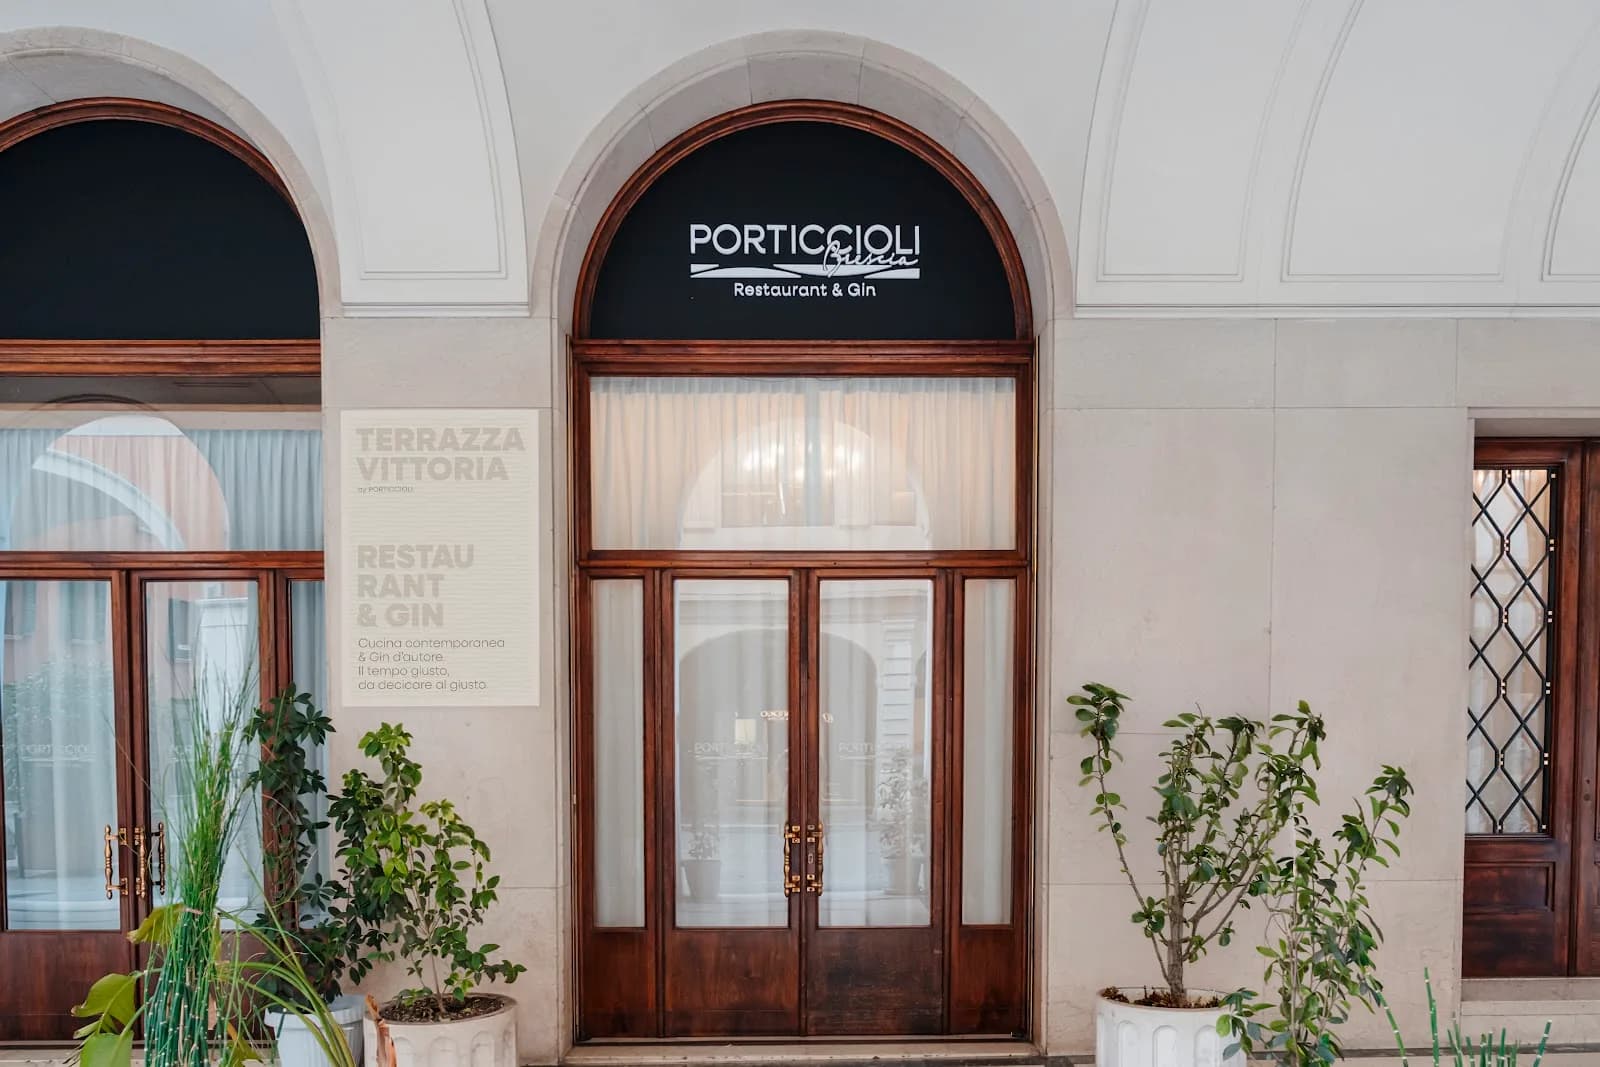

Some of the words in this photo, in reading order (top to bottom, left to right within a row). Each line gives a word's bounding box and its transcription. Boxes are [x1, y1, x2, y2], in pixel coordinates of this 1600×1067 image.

[690, 223, 920, 255] PORTICCIOLI
[822, 239, 919, 278] Brescia
[734, 282, 828, 297] Restaurant
[832, 283, 843, 297] &
[848, 282, 876, 297] Gin
[355, 427, 526, 452] TERRAZZA
[356, 456, 510, 481] VITTORIA
[357, 544, 474, 569] RESTAU
[357, 573, 445, 598] RANT
[357, 603, 377, 627] &
[385, 603, 444, 627] GIN
[358, 637, 402, 649] Cucina
[405, 638, 505, 650] contemporanea
[358, 652, 367, 662] &
[369, 651, 390, 662] Gin
[358, 665, 364, 676] Il
[367, 667, 408, 678] tempo
[411, 665, 450, 679] giusto,
[358, 680, 375, 690] da
[436, 680, 447, 690] al
